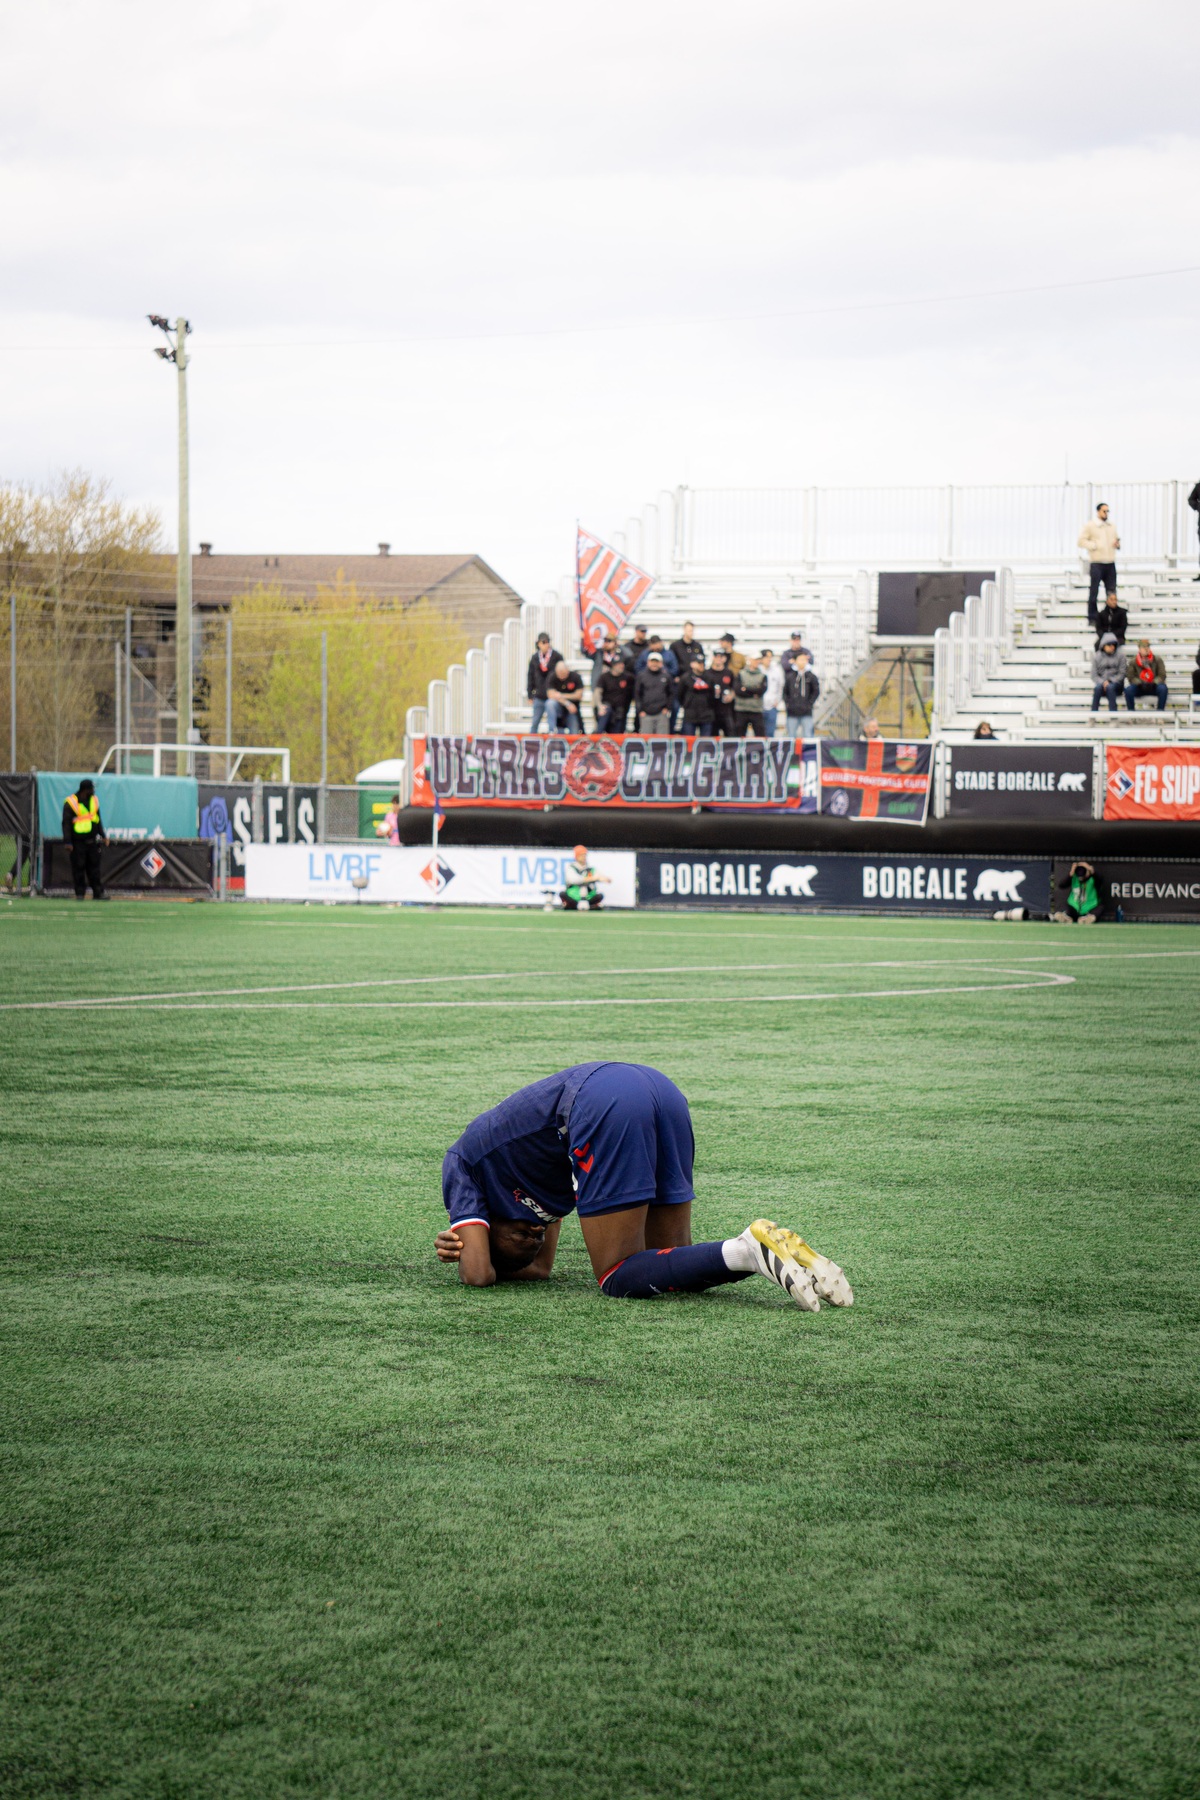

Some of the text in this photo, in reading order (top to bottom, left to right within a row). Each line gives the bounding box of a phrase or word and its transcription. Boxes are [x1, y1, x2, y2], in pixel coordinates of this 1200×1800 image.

[428, 736, 570, 801] ULTRAS
[619, 736, 796, 803] CALGARY
[955, 770, 1056, 792] STADE BORÉALE
[1133, 765, 1158, 804] FC
[309, 853, 380, 881] LMBF
[660, 861, 762, 896] BORÉALE
[862, 865, 968, 901] BORÉALE
